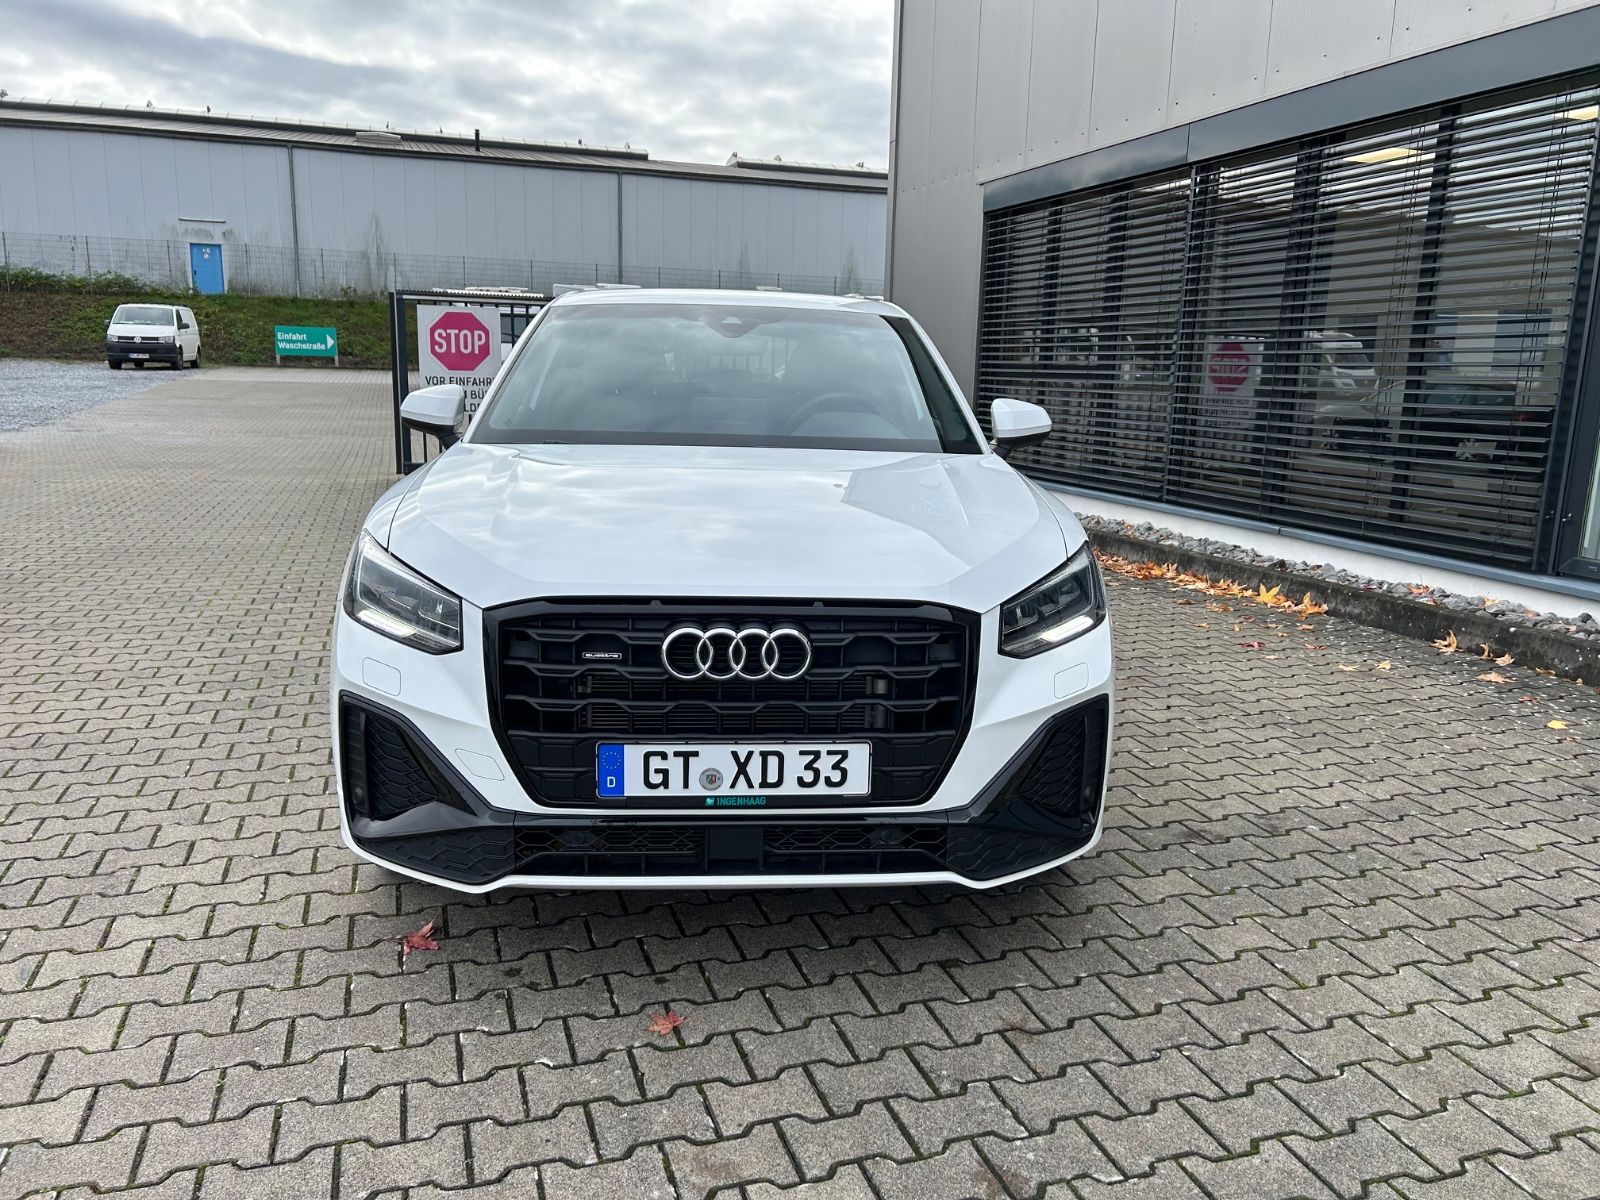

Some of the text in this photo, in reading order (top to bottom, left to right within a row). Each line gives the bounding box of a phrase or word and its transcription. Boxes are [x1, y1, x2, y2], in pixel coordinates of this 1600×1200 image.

[277, 331, 307, 341] Einfahrt
[433, 328, 486, 354] STOP
[277, 341, 326, 351] Waschstraße
[425, 375, 495, 387] VOR EINFAHR
[470, 388, 487, 400] BÜ
[642, 750, 700, 790] GT
[729, 749, 785, 789] XD
[796, 749, 849, 788] 33
[607, 776, 616, 788] D
[716, 796, 767, 806] INGENHAAG
